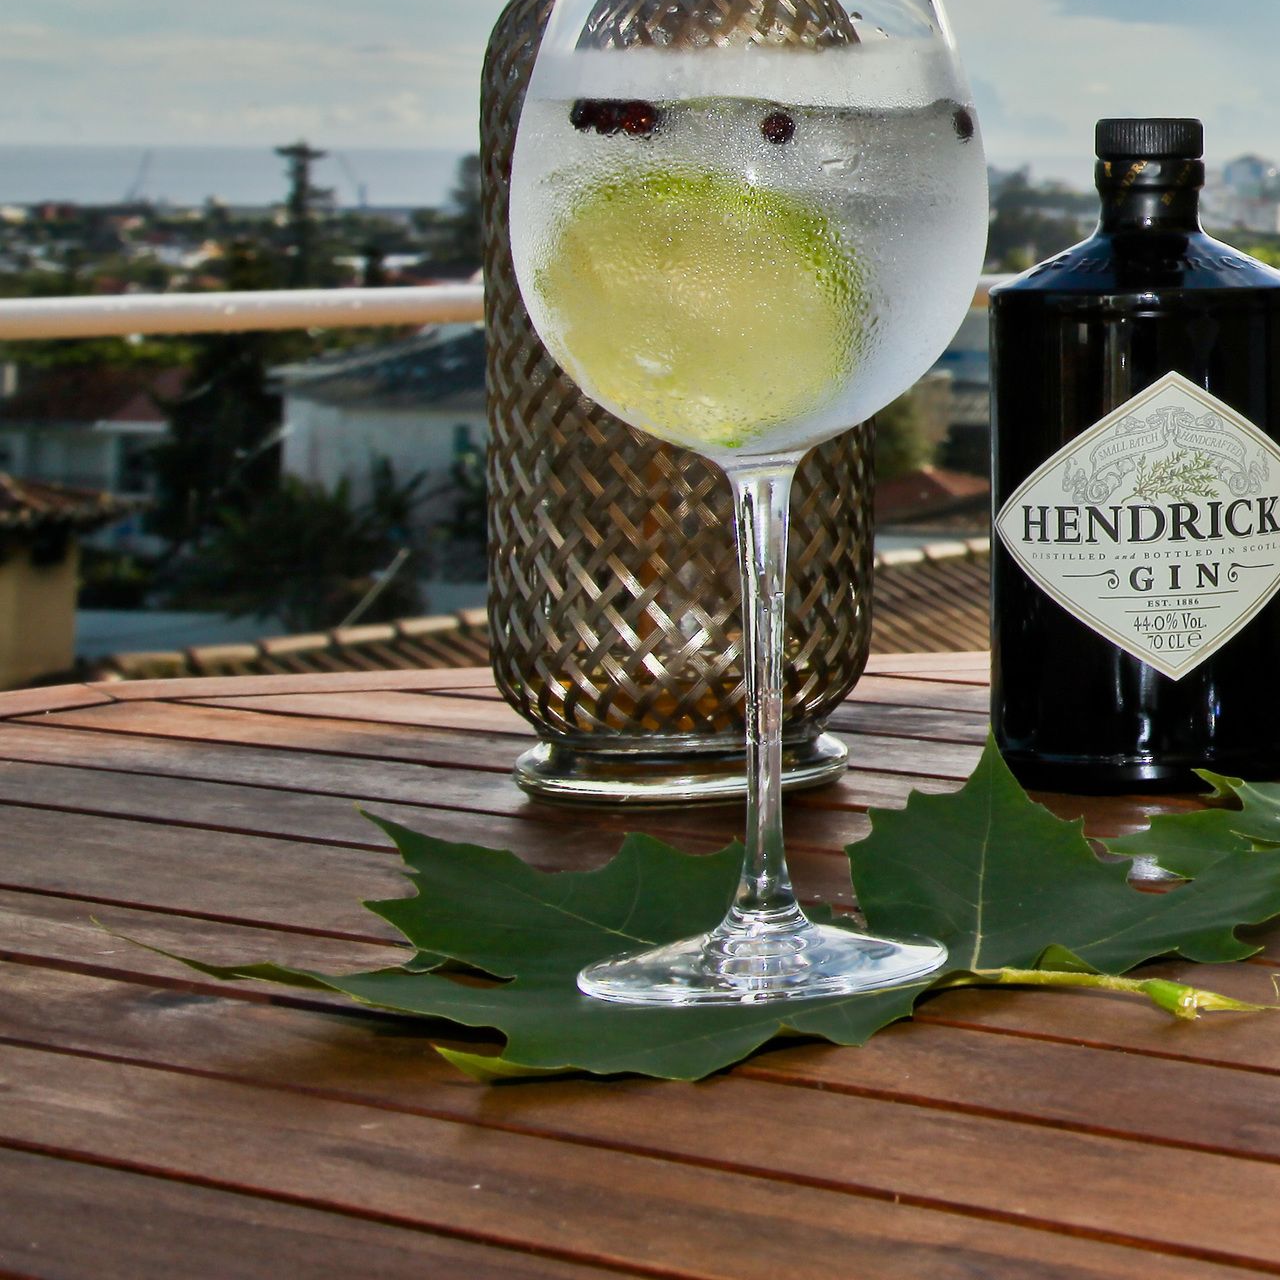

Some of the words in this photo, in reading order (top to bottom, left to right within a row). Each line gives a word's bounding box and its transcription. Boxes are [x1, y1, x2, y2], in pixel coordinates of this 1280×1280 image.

[1097, 441, 1128, 461] SMALL
[1129, 432, 1158, 448] BATCH
[1180, 431, 1243, 457] HANDCRAFTED
[1032, 552, 1106, 561] DISTILLED
[1115, 552, 1136, 560] and
[1144, 548, 1213, 559] BOTTLED
[1220, 546, 1236, 555] IN
[1129, 562, 1221, 591] GIN
[1147, 600, 1172, 608] EST.
[1176, 598, 1200, 606] 1886
[1147, 634, 1163, 650] 70
[1168, 633, 1185, 650] CL
